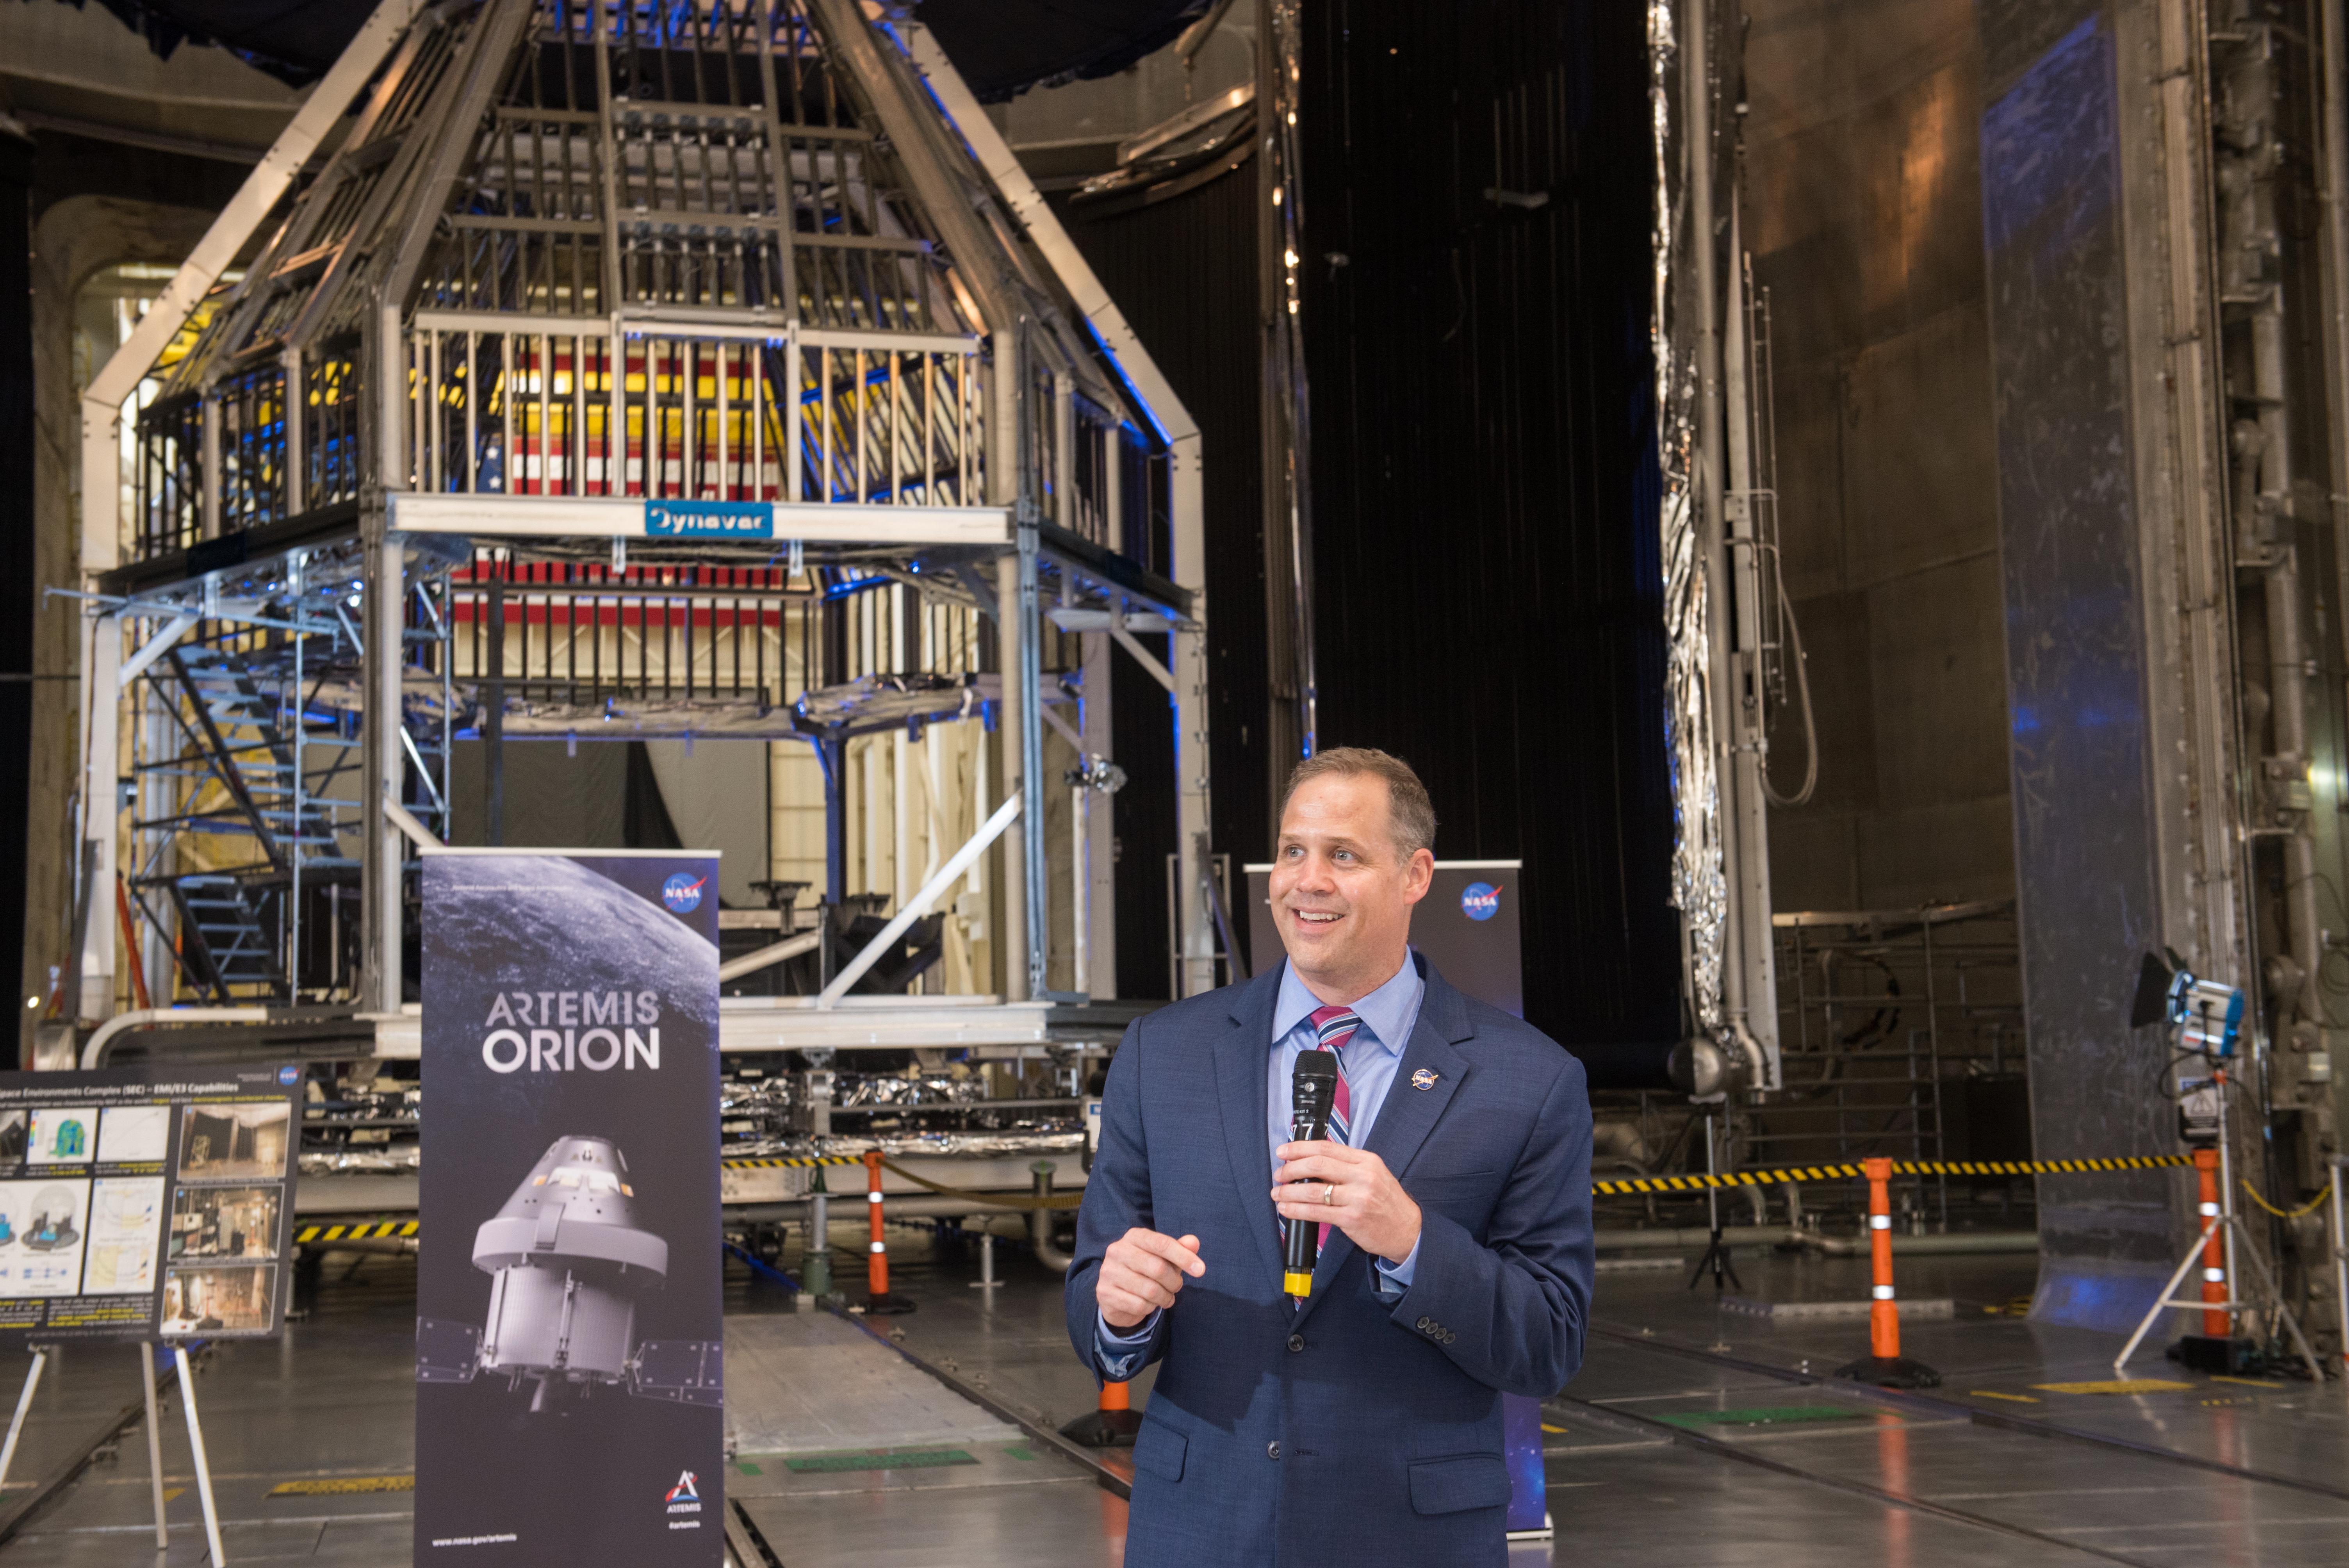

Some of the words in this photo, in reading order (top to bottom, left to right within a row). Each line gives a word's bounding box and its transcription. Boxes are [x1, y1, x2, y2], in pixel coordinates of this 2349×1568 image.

[650, 508, 765, 534] Dynavac
[665, 887, 700, 898] NASA
[1464, 896, 1496, 906] NASA
[485, 991, 659, 1027] ARTEMIS
[482, 1026, 659, 1073] ORION
[1302, 1123, 1314, 1140] 7
[667, 1503, 701, 1514] ARTEMIS
